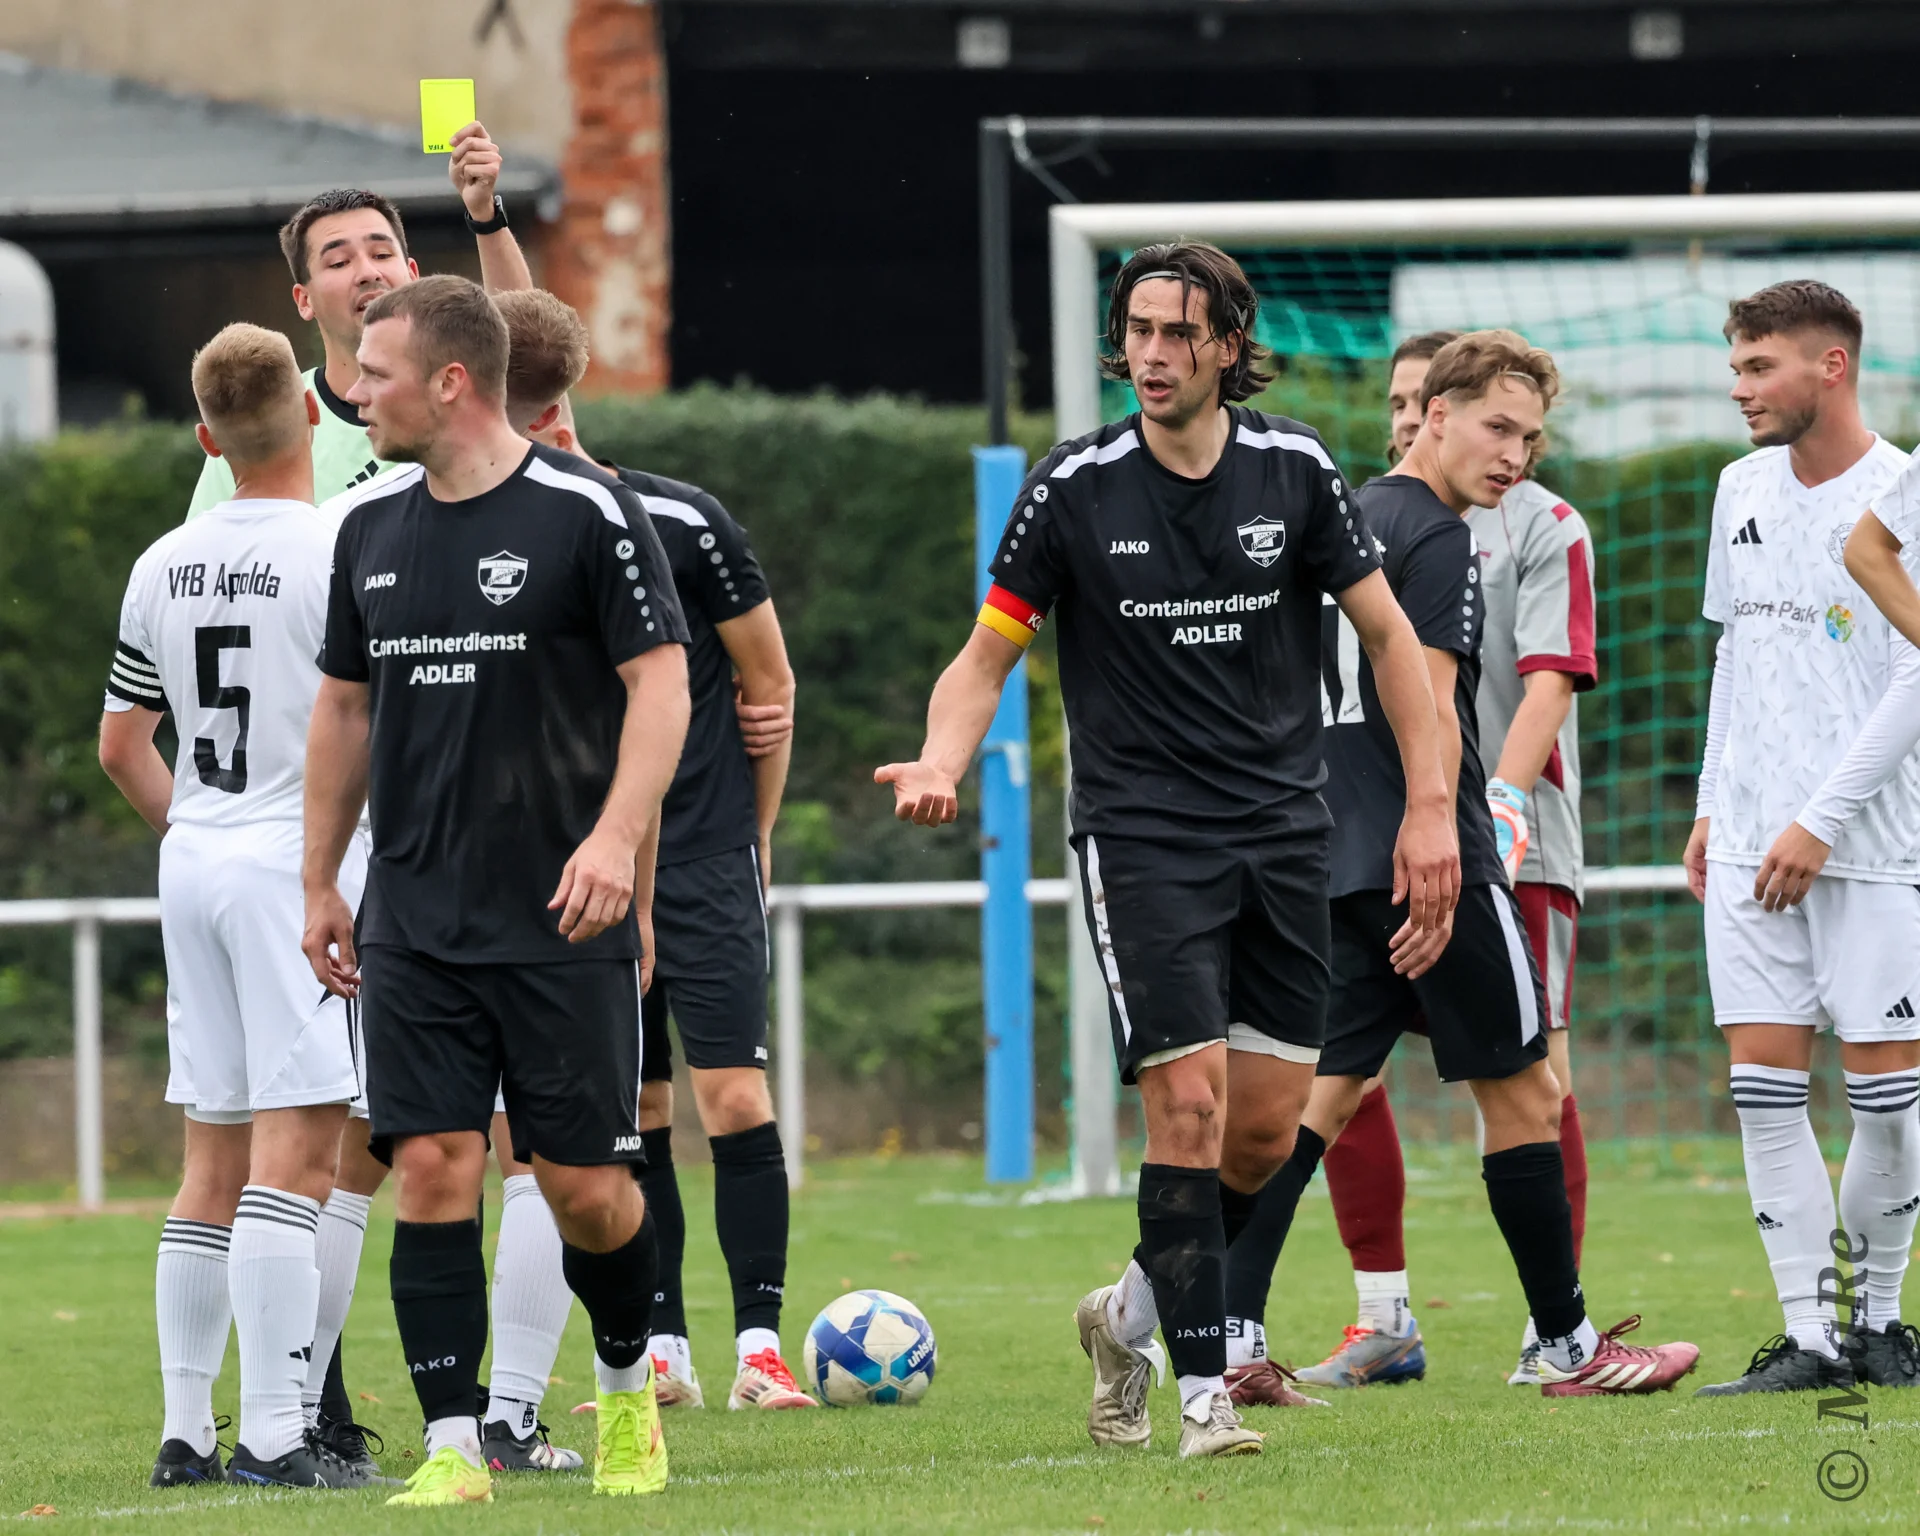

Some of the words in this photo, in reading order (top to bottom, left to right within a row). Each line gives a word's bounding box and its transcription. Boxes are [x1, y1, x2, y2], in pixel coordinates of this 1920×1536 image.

[1109, 540, 1150, 555] JAKO
[168, 562, 207, 600] VfB
[213, 561, 281, 603] Apolda
[364, 572, 397, 592] JAKO
[369, 632, 527, 658] Containerdienst
[1171, 623, 1243, 646] ADLER
[409, 663, 476, 685] ADLER
[193, 625, 252, 795] 5
[614, 1135, 642, 1152] JAKO
[1176, 1325, 1220, 1339] JAKO
[907, 1331, 935, 1368] uhlsp
